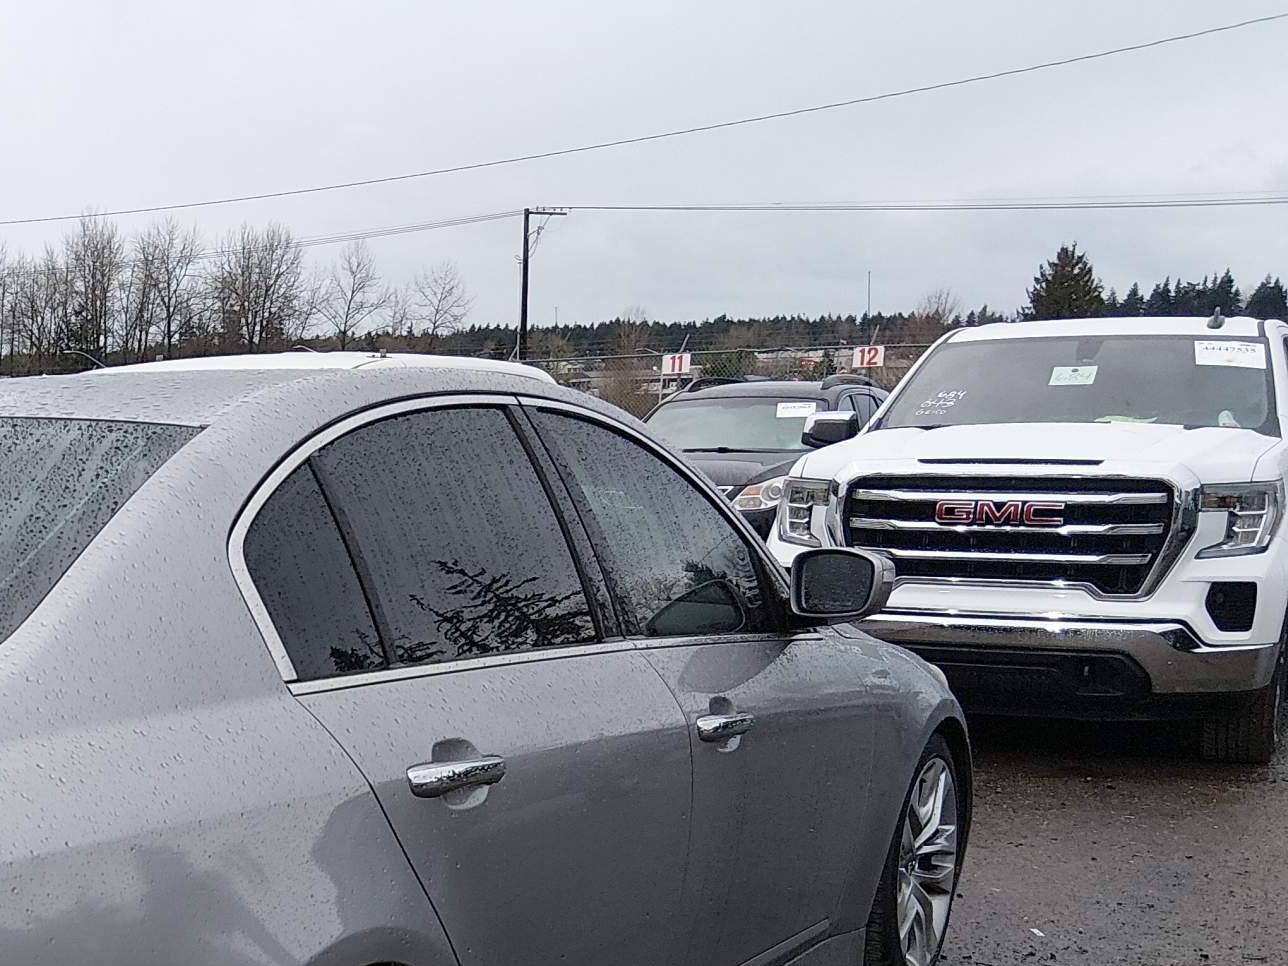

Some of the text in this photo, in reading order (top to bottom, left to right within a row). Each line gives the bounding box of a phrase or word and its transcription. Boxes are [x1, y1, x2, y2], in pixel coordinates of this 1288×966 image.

[669, 354, 684, 373] 11
[859, 346, 879, 366] 12
[935, 500, 1065, 525] GMC
